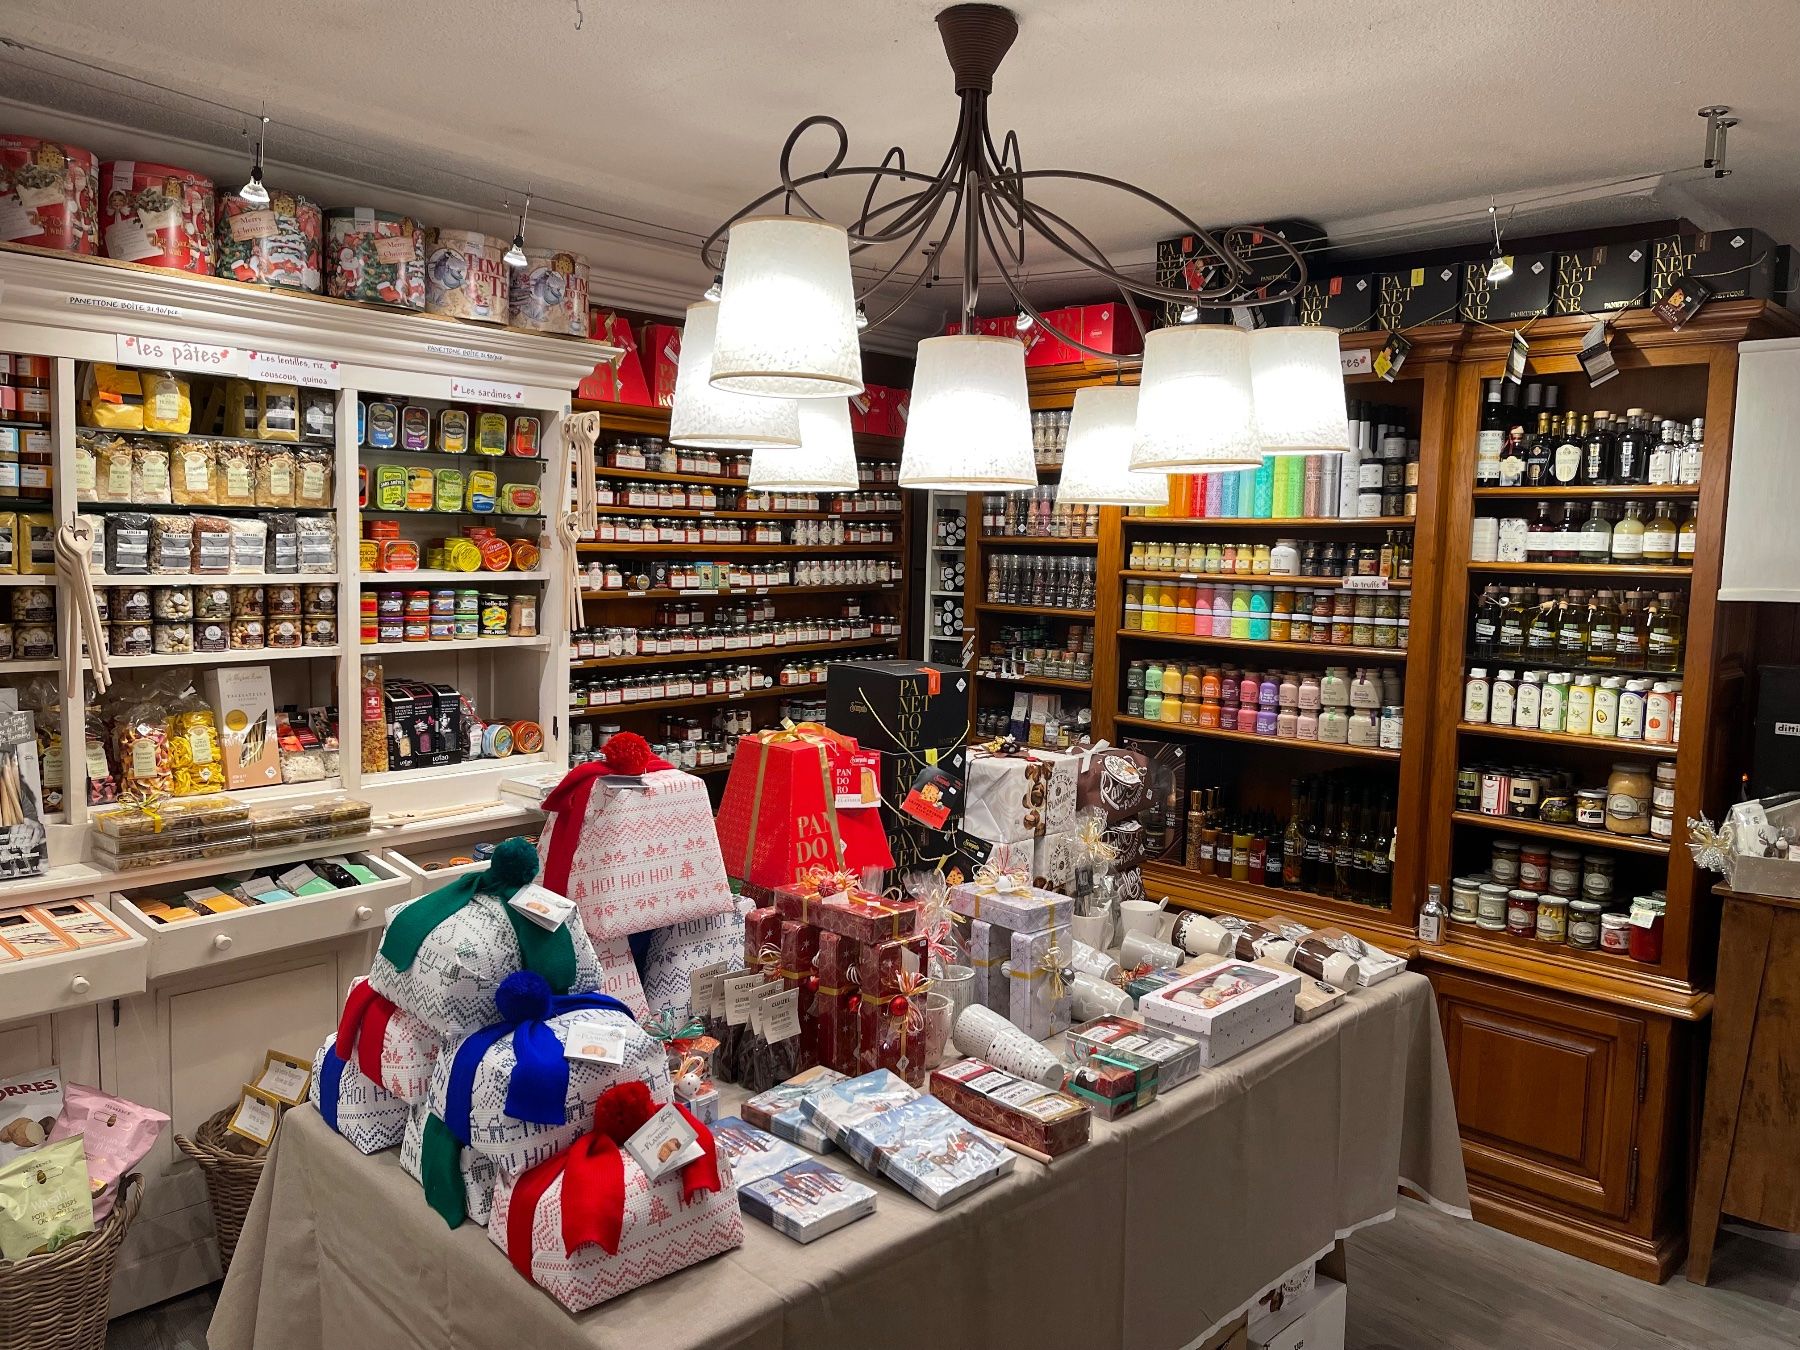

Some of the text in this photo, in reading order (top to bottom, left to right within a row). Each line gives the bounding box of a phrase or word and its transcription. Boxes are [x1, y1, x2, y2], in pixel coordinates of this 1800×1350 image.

[240, 215, 262, 225] Merry
[1656, 240, 1680, 258] PA
[1559, 254, 1582, 270] PA
[1654, 253, 1697, 274] NET
[1467, 263, 1488, 279] PA
[1558, 266, 1597, 285] NET
[1382, 275, 1401, 290] PA
[1557, 282, 1584, 299] TO
[1303, 284, 1320, 298] PA
[1380, 286, 1415, 303] NET
[69, 296, 118, 308] PANETTONE
[1301, 294, 1333, 311] NET
[1465, 292, 1490, 307] TO
[1556, 297, 1581, 314] NE
[1301, 309, 1322, 324] TO
[1380, 302, 1403, 317] TO
[1464, 305, 1489, 321] NE
[1379, 315, 1401, 331] NE
[173, 344, 221, 365] pâtes
[261, 354, 275, 363] Les
[427, 345, 460, 356] PANETTONE
[260, 371, 328, 386] couscous, quinoa
[461, 385, 512, 400] Les sardines
[1351, 580, 1380, 589] la truffe
[900, 679, 920, 697] PA
[899, 695, 933, 713] NET
[897, 713, 921, 732] TO
[898, 730, 920, 748] NE
[836, 768, 852, 777] PAN
[896, 758, 916, 777] PA
[836, 777, 850, 785] DO
[836, 786, 849, 794] RO
[795, 836, 828, 864] DO
[591, 865, 673, 896] HO! HO! HO!
[678, 914, 726, 938] HO! HO!
[699, 969, 719, 979] CLUIZEL
[734, 982, 754, 990] CLUIZEL
[771, 997, 791, 1008] CLUIZEL
